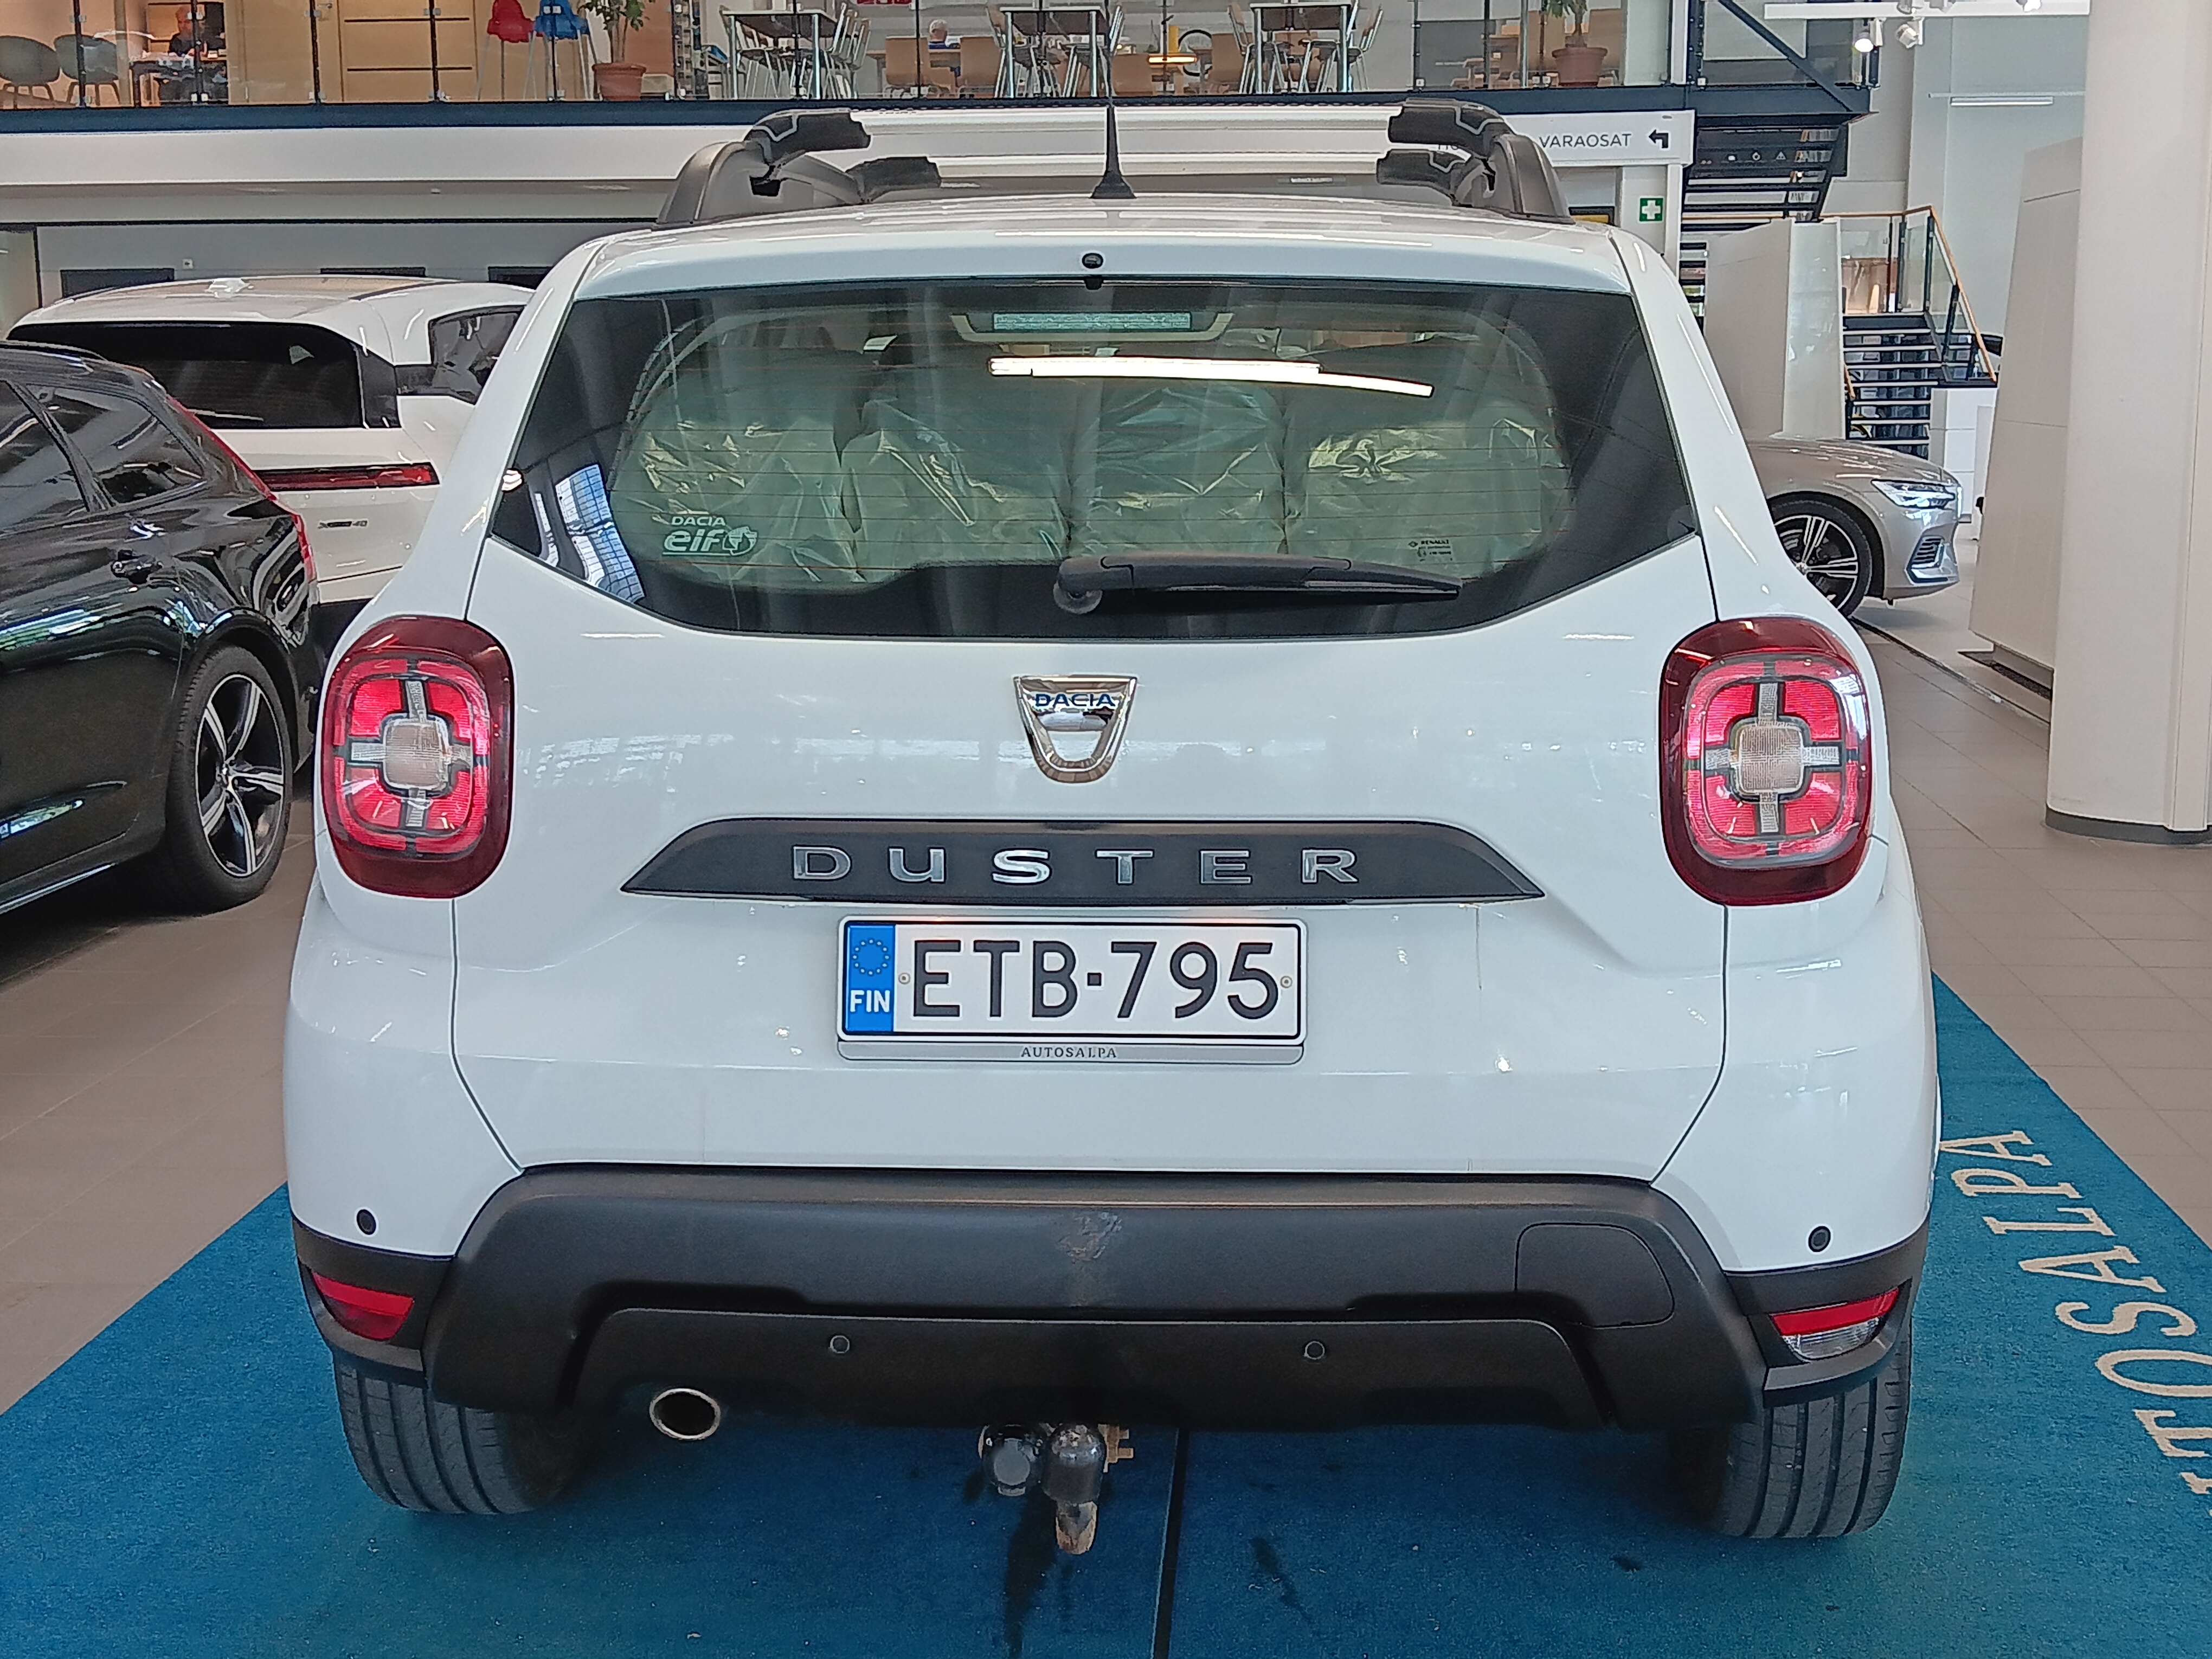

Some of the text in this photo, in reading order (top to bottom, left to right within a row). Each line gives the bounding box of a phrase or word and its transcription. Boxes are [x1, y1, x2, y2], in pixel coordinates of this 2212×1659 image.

[1539, 134, 1631, 148] VARAOSAT
[671, 516, 726, 526] DACIA
[1035, 693, 1116, 707] DACIA
[792, 846, 1358, 884] DUSTER
[850, 989, 891, 1013] FIN
[1021, 1047, 1117, 1058] AUTOSALPA
